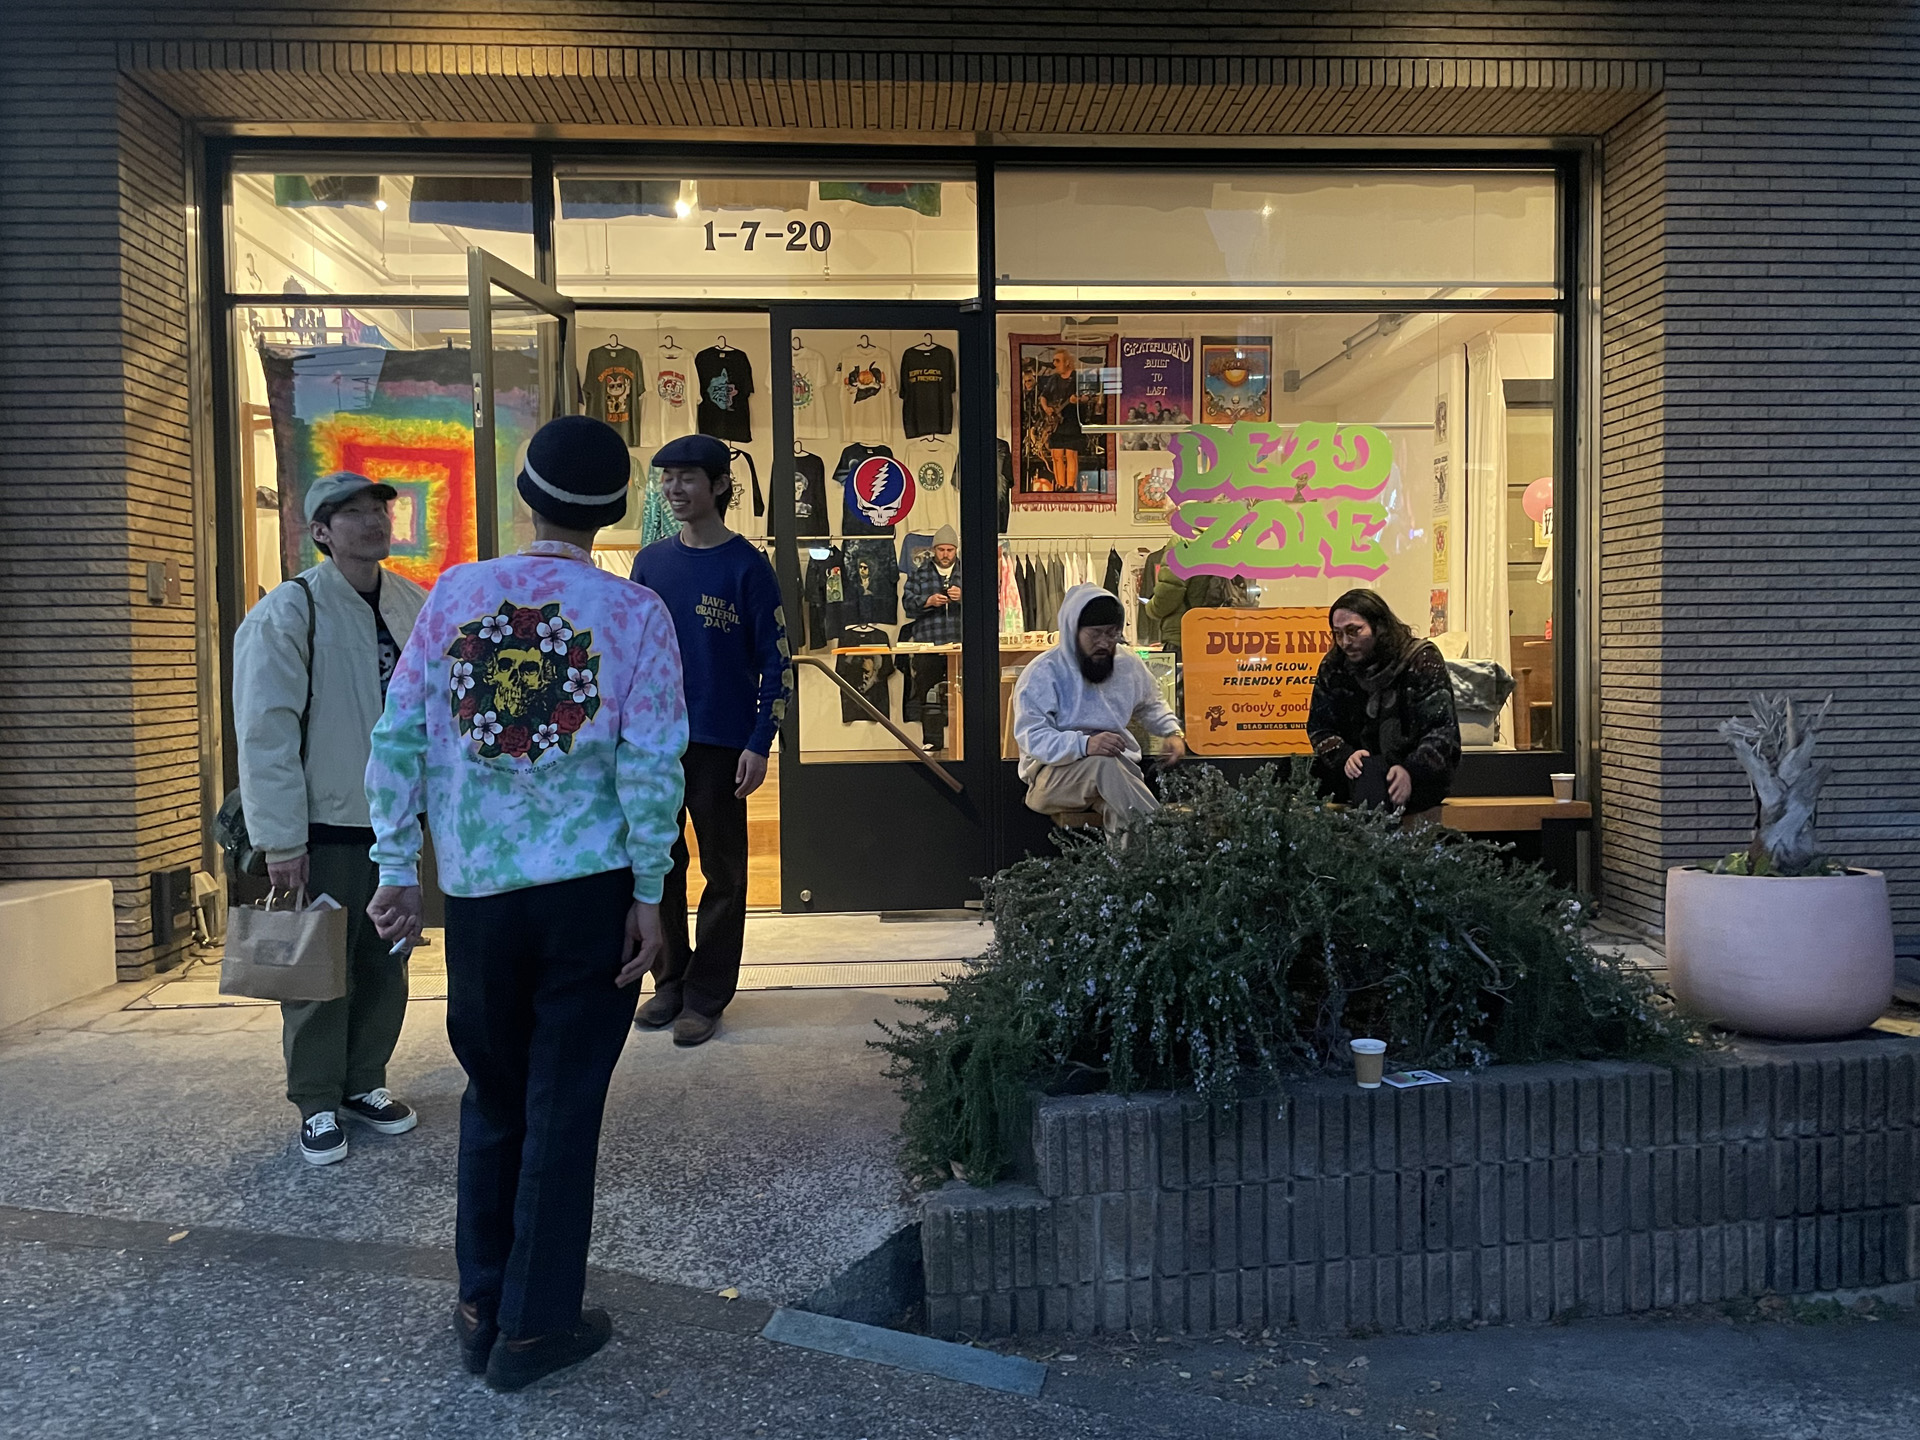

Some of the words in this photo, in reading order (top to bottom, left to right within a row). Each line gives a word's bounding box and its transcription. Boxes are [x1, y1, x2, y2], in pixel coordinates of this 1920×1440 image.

[703, 220, 831, 251] 1-7-20
[1143, 359, 1170, 368] BUILT
[1151, 373, 1163, 382] TO
[1145, 386, 1168, 396] LAST
[1166, 420, 1393, 502] DEAD
[1166, 500, 1389, 582] ZONE
[701, 593, 726, 609] HAVE
[728, 603, 736, 613] A
[695, 604, 740, 625] GRATEFUL
[1206, 631, 1280, 654] DUDE
[1237, 663, 1272, 671] WARM
[1276, 662, 1312, 671] GLOW,
[1223, 676, 1283, 685] FRIENDLY
[1286, 675, 1317, 685] FACE
[1273, 689, 1282, 697] &
[1232, 701, 1275, 717] Groovy
[1277, 698, 1310, 717] good
